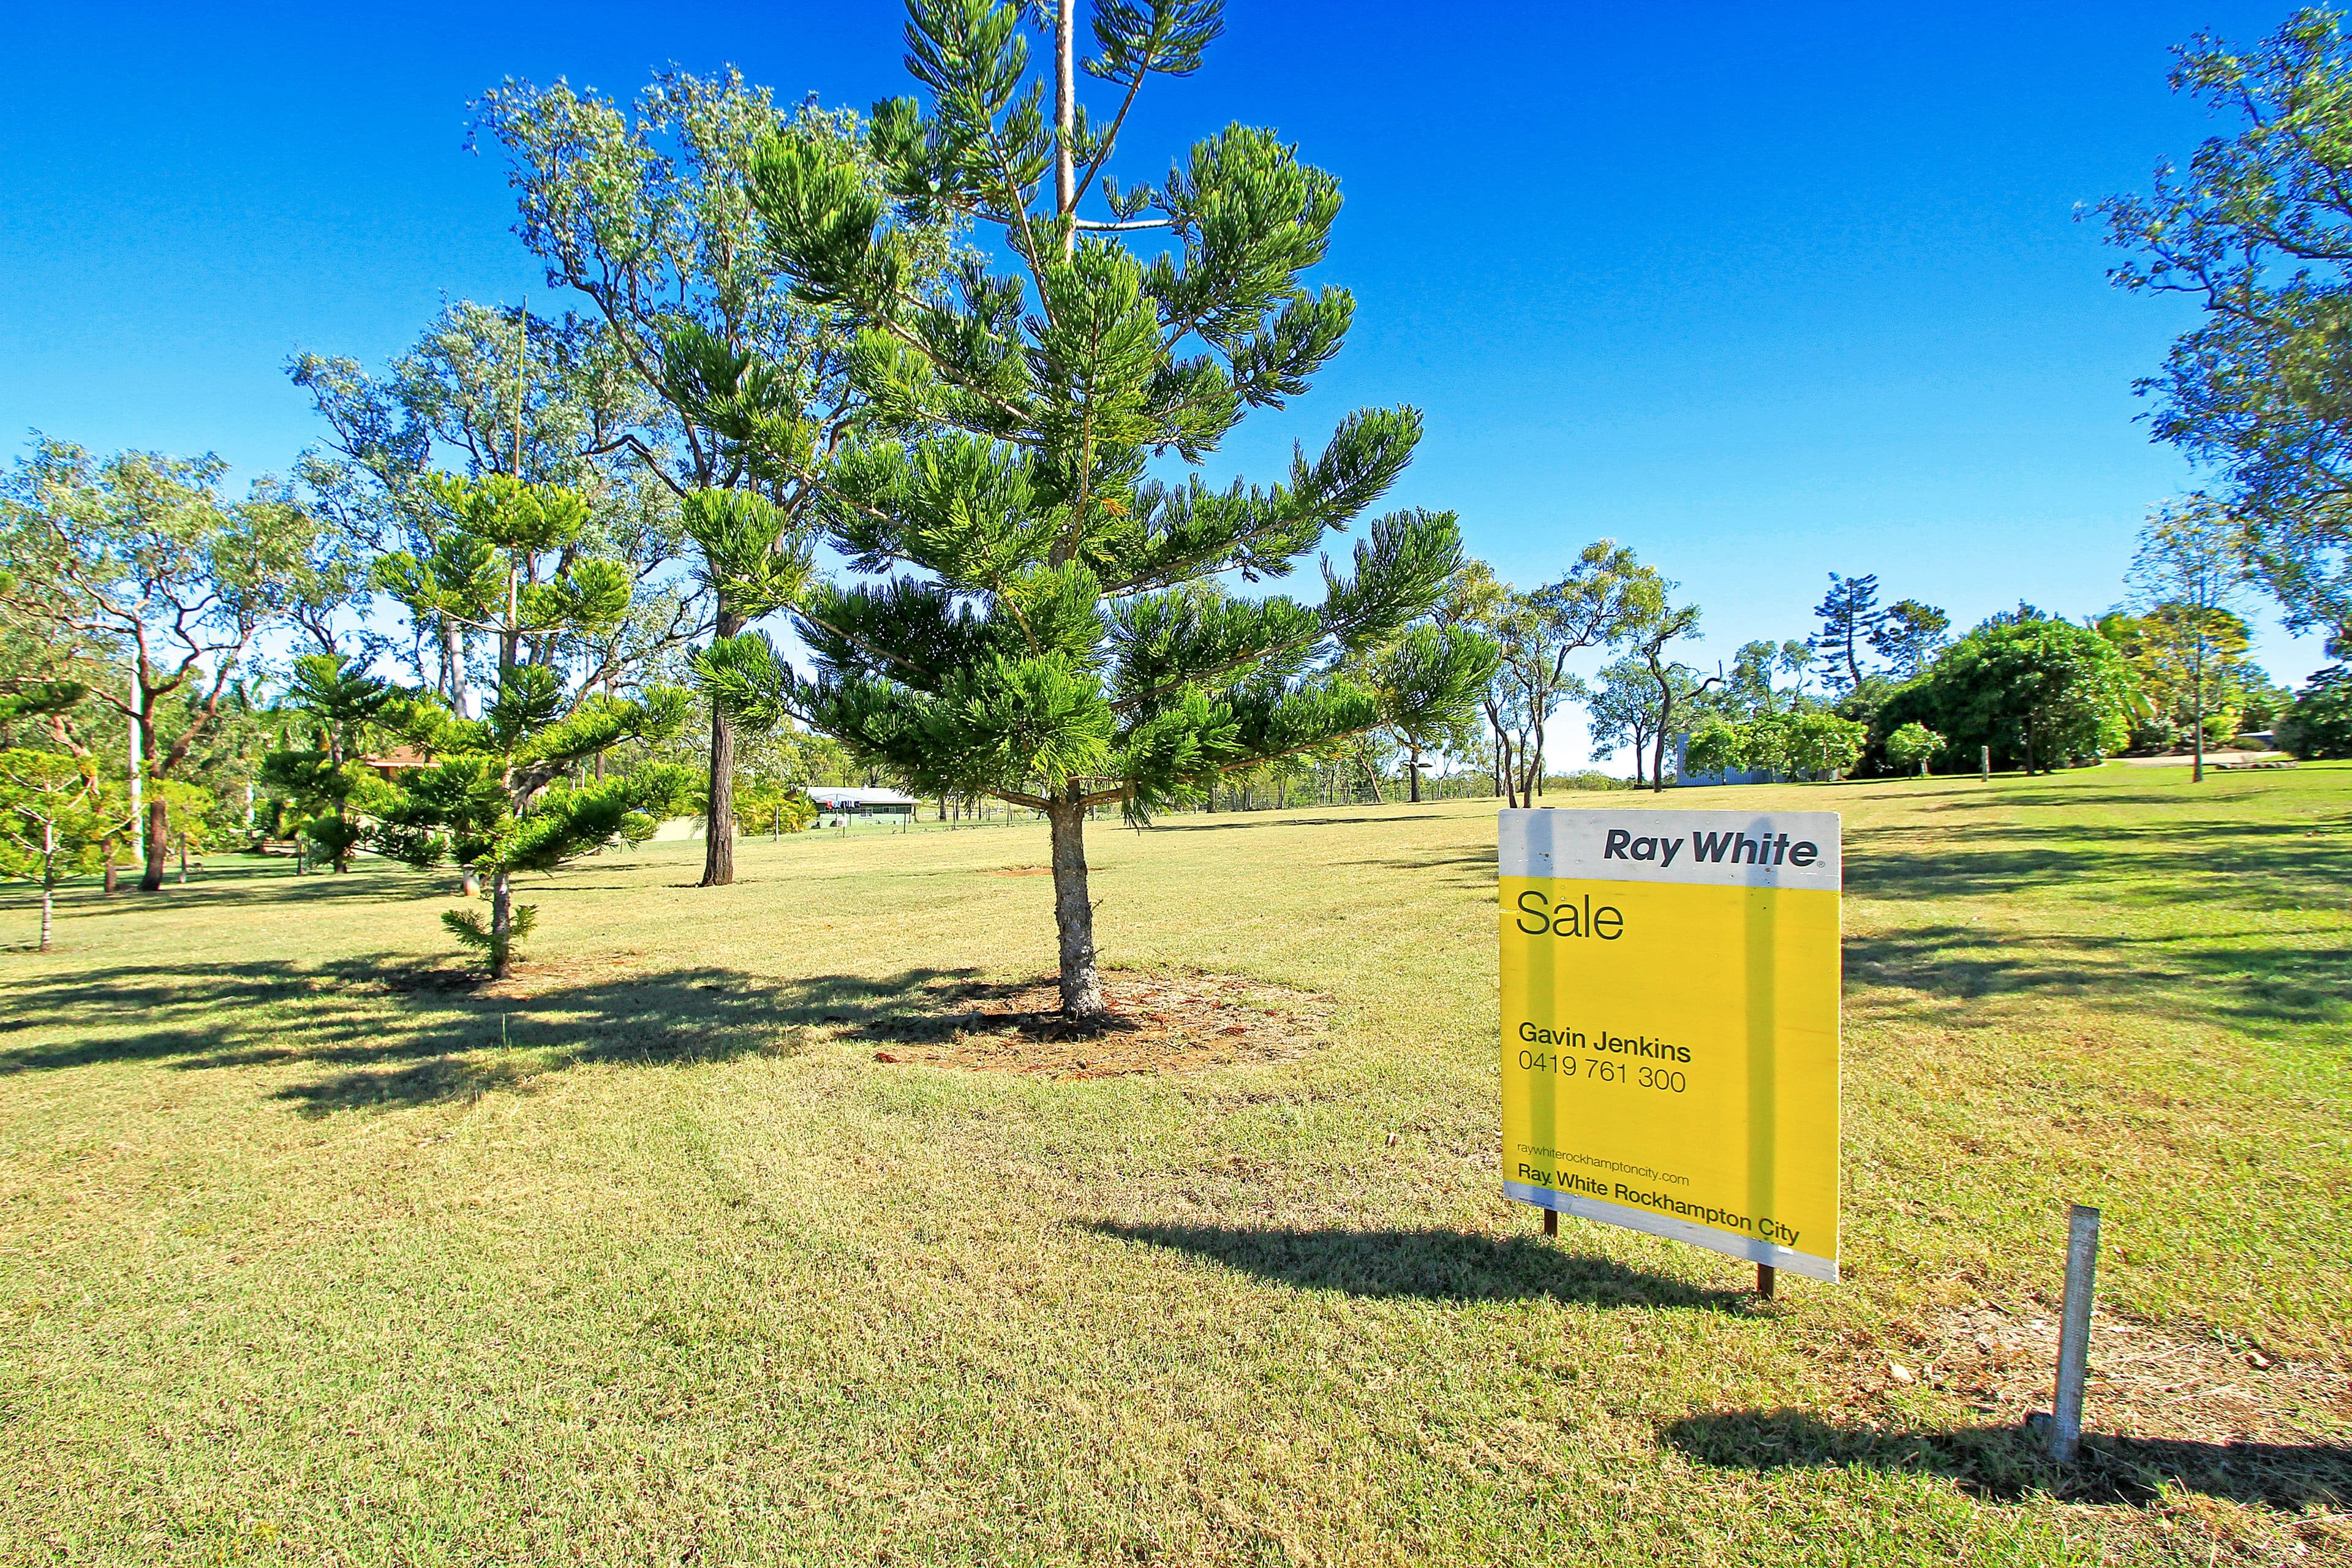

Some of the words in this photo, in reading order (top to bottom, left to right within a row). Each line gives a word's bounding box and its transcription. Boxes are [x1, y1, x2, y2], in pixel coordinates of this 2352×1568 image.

[1604, 829, 1684, 867] Ray
[1692, 831, 1818, 867] White
[1516, 891, 1624, 940] Sale
[1518, 1022, 1586, 1048] Gavin
[1593, 1031, 1691, 1063] Jenkins
[1518, 1050, 1577, 1076] 0419
[1585, 1059, 1626, 1083] 761
[1638, 1067, 1686, 1093] 300
[1517, 1142, 1689, 1186] raywhiterockhamptoncity.com
[1518, 1163, 1550, 1186] Ray
[1556, 1170, 1608, 1195] White
[1615, 1184, 1752, 1231] Rockhampton
[1758, 1218, 1800, 1246] City
